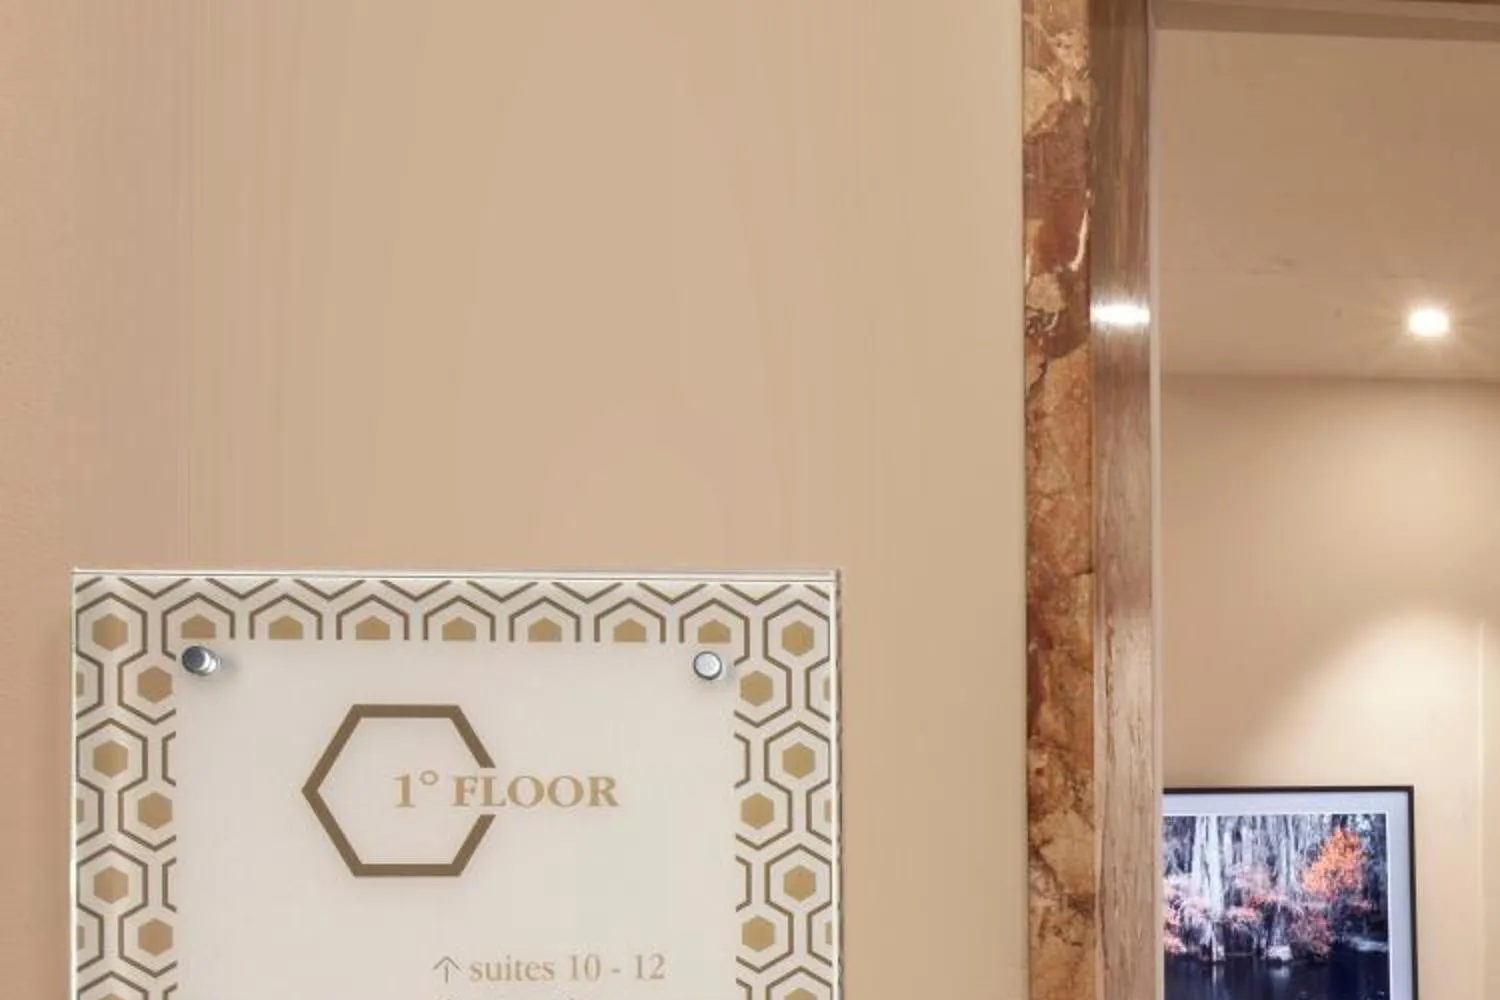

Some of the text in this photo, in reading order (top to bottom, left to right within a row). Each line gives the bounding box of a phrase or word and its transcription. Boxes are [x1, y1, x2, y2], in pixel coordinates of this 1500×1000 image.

[452, 774, 619, 809] FLOOR
[469, 954, 555, 983] suites
[568, 953, 602, 981] 10
[634, 953, 666, 980] 12
